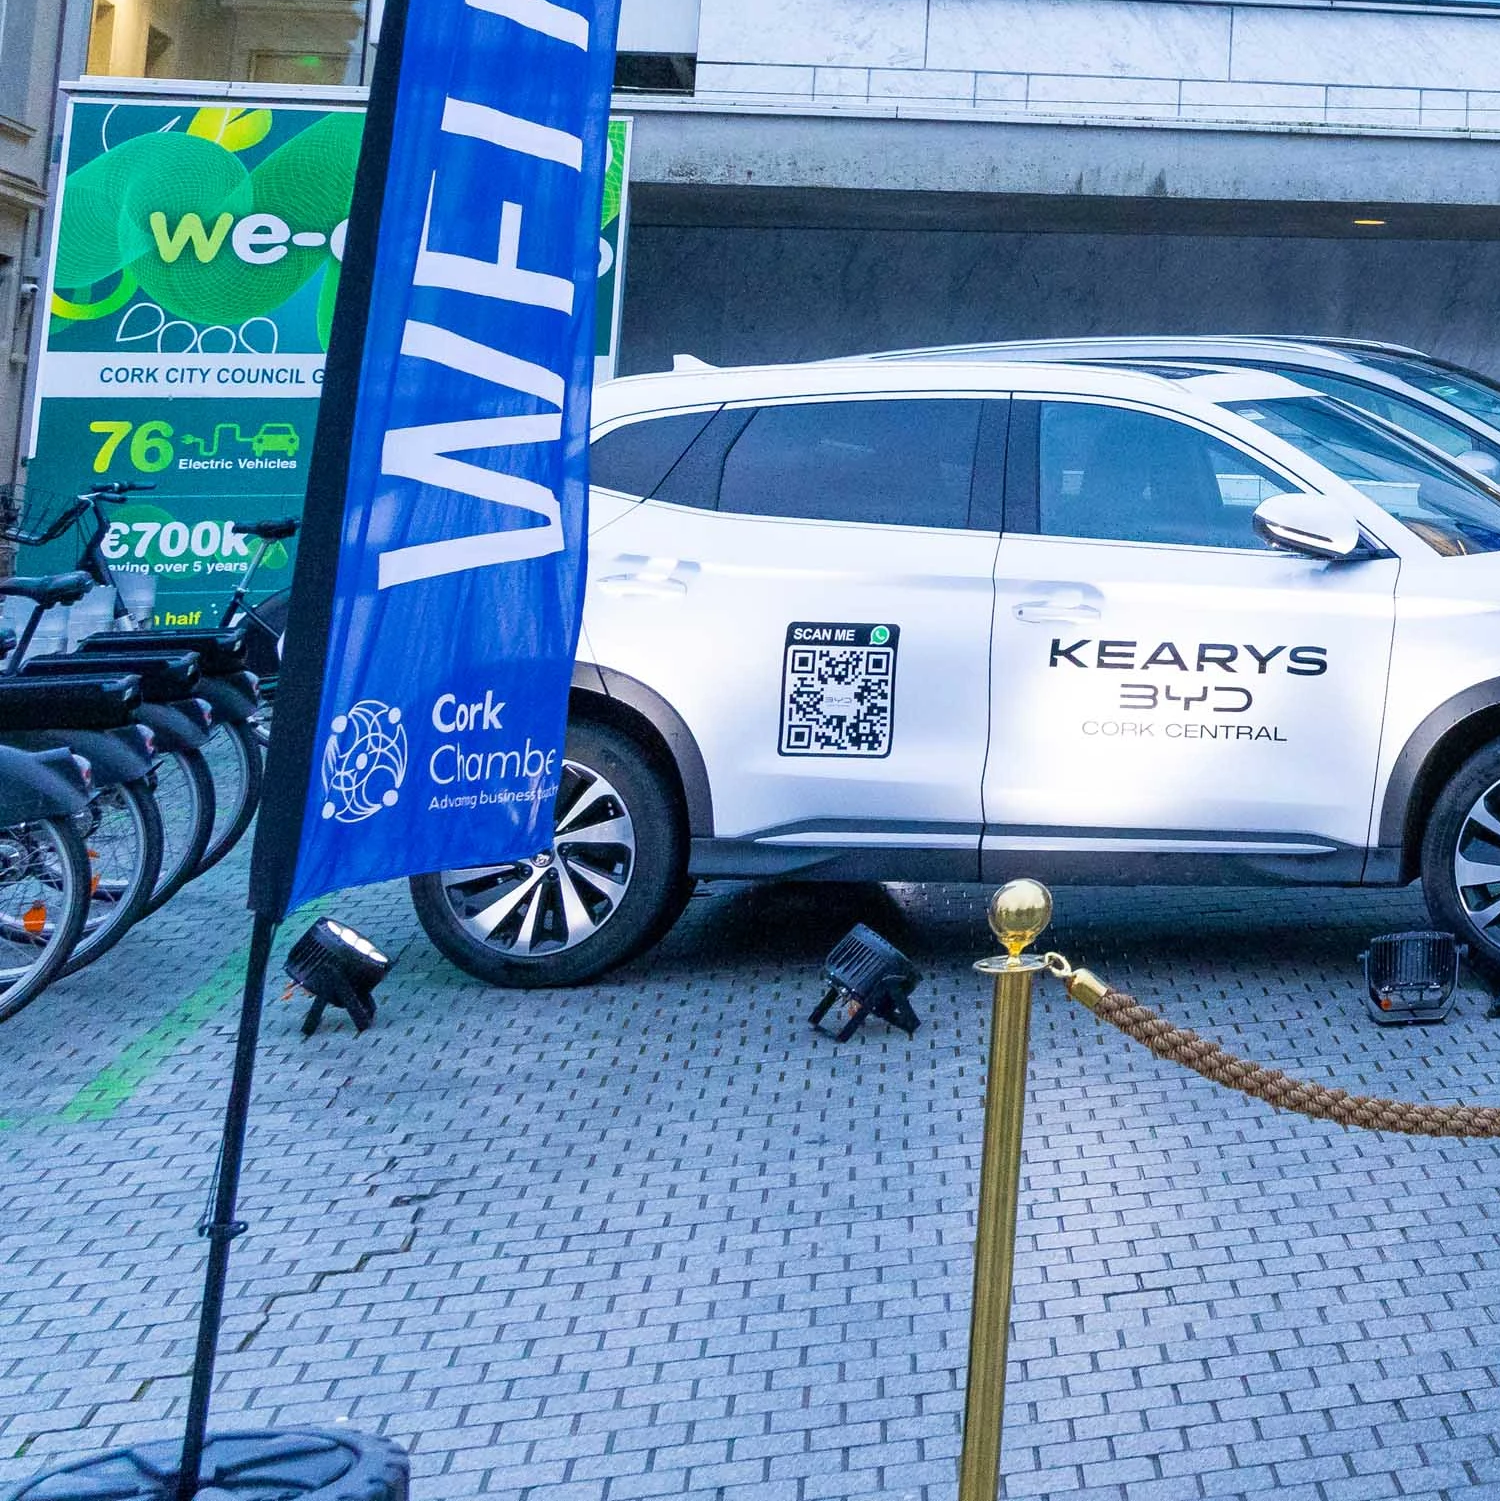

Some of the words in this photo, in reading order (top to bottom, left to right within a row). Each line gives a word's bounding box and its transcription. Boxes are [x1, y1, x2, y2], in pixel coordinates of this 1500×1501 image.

[100, 367, 159, 384] CORK
[165, 367, 211, 385] CITY
[216, 368, 306, 385] COUNCIL
[89, 420, 175, 473] 76
[178, 458, 233, 470] Electric
[238, 458, 297, 470] Vehicles
[108, 562, 150, 575] aving
[154, 563, 189, 573] over
[193, 561, 202, 573] 5
[206, 562, 248, 575] years
[165, 611, 202, 626] half
[793, 628, 832, 640] SCAN
[834, 629, 855, 641] ME
[1049, 638, 1328, 676] KEARYS
[1119, 683, 1253, 713] BYD
[431, 690, 507, 733] Cork
[1082, 720, 1155, 738] CORK
[1165, 723, 1288, 742] CENTRAL
[429, 738, 557, 785] Chambe
